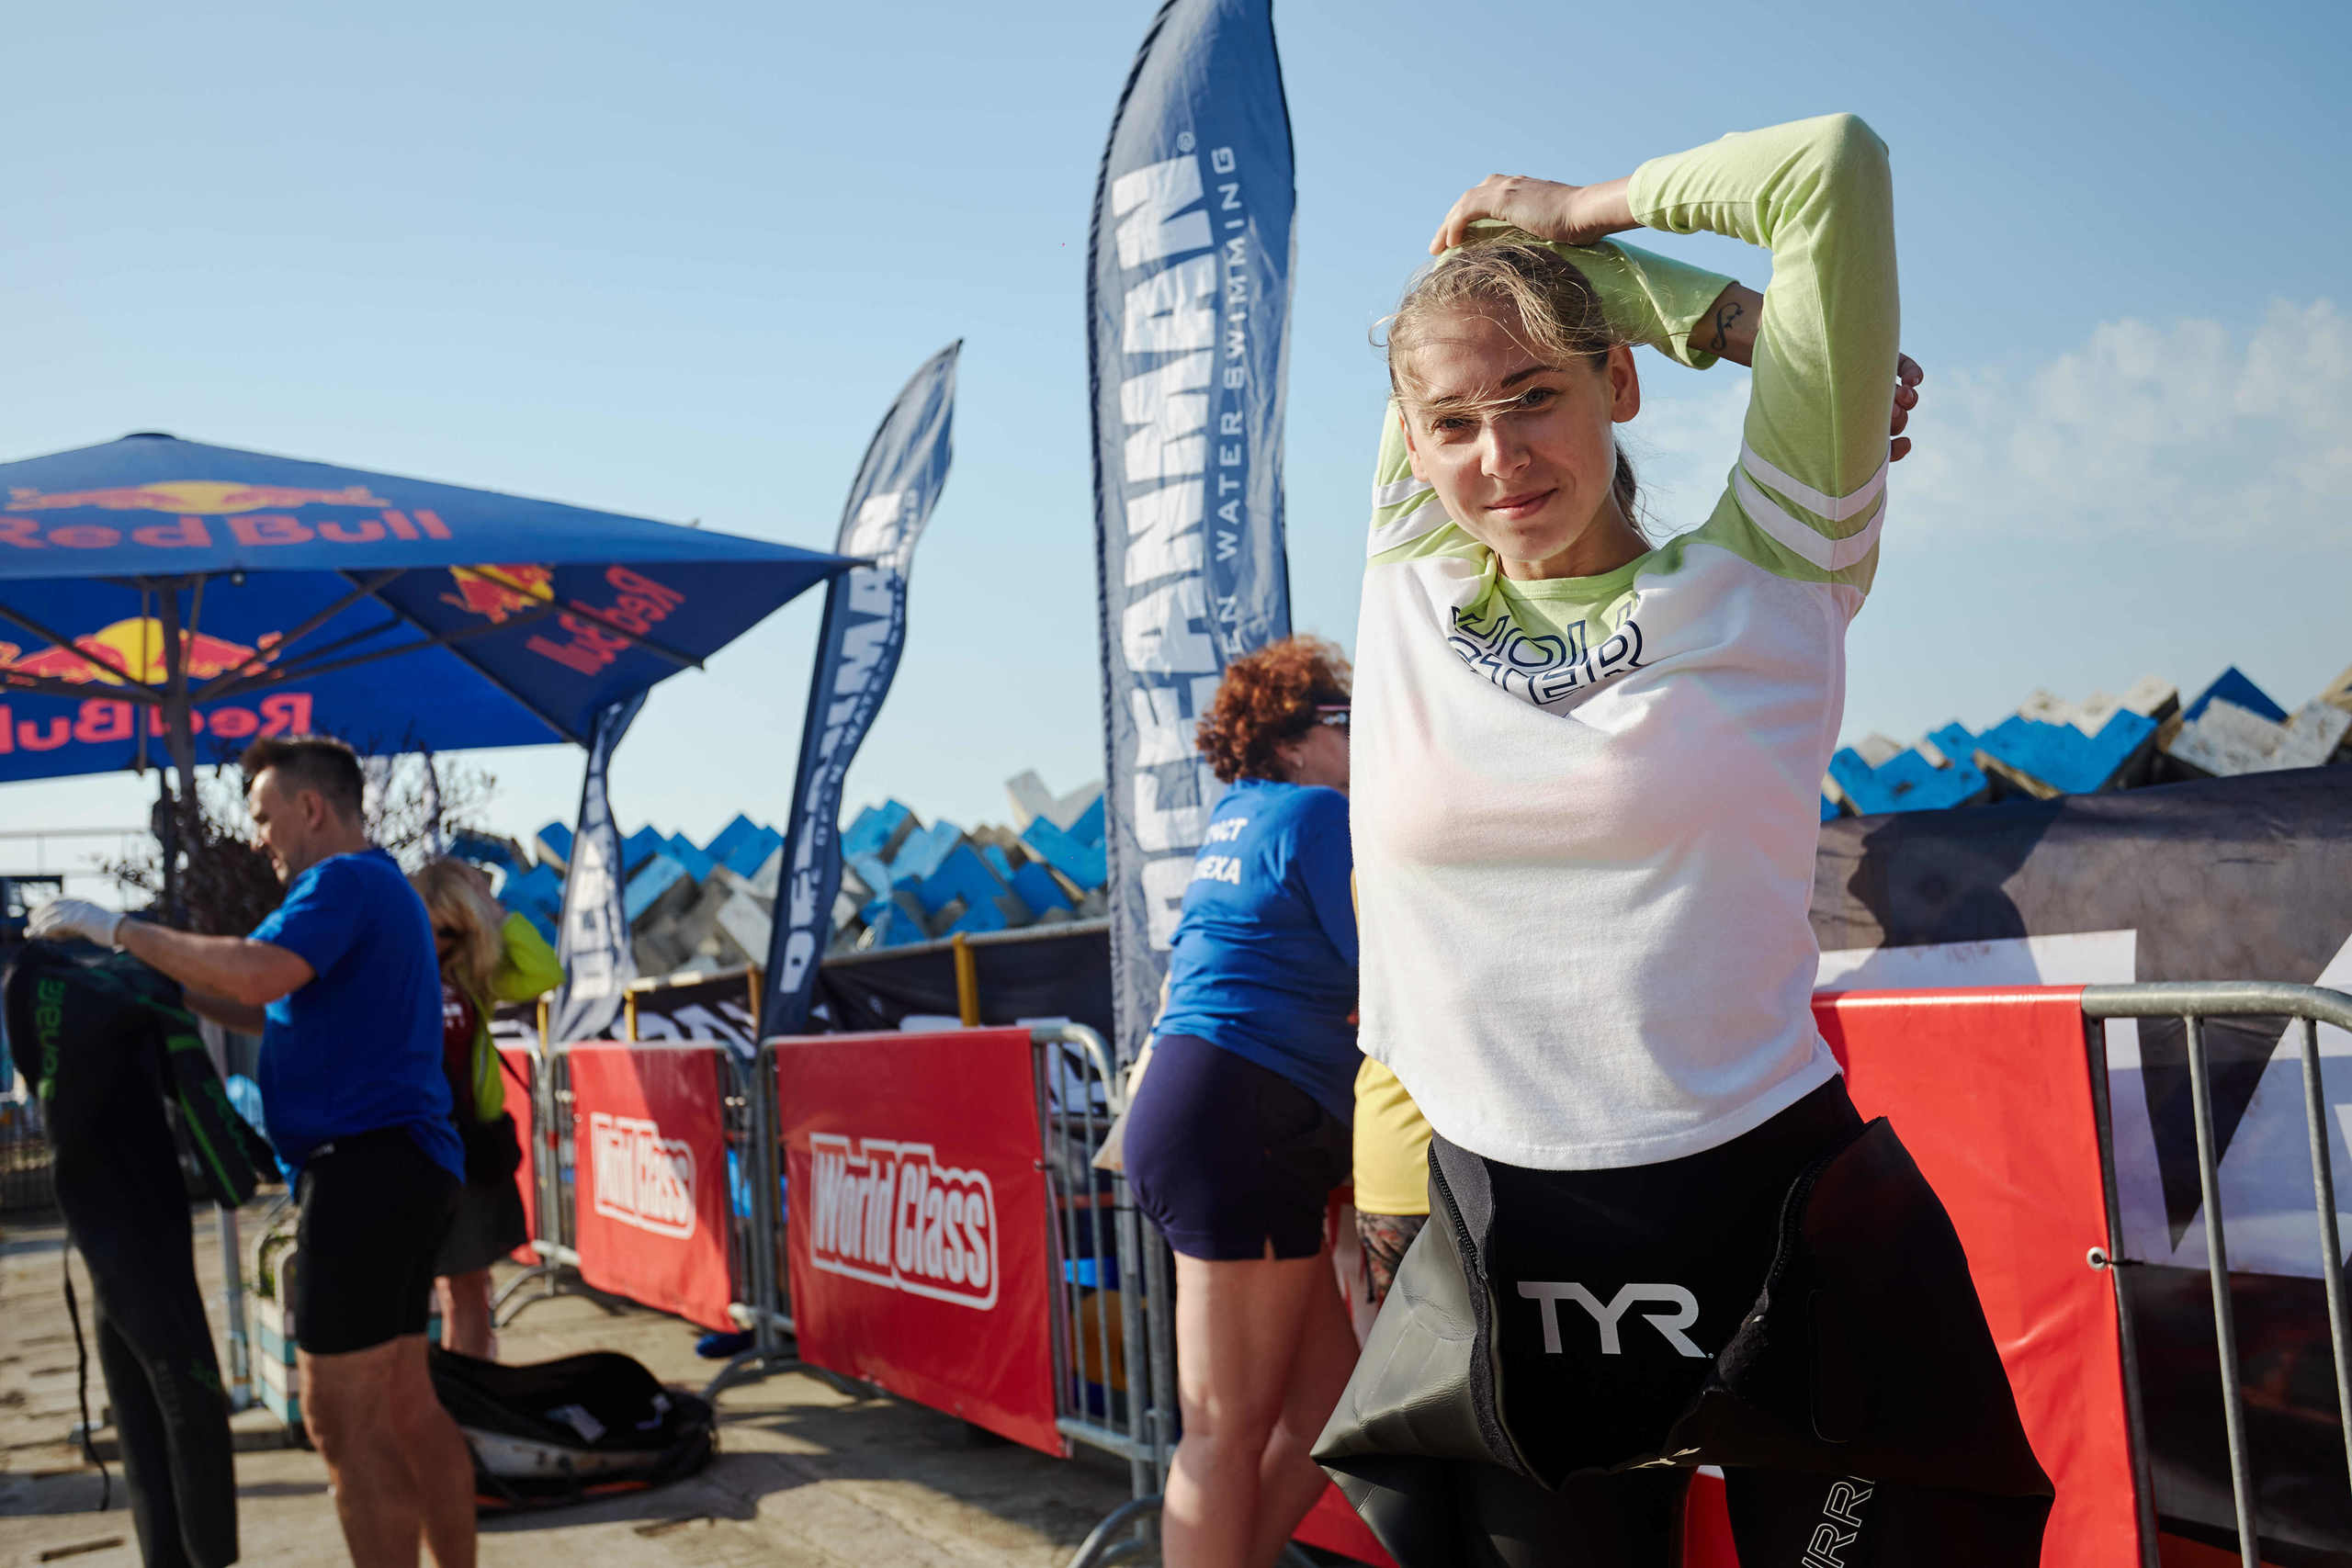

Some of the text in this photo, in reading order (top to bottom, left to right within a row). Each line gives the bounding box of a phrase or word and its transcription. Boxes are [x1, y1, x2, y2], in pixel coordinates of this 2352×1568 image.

[1210, 145, 1248, 391] SWIMMING
[0, 509, 452, 548] Red Bull
[1215, 409, 1244, 564] WATER
[815, 1150, 989, 1289] World Class
[1517, 1280, 1707, 1359] TYR
